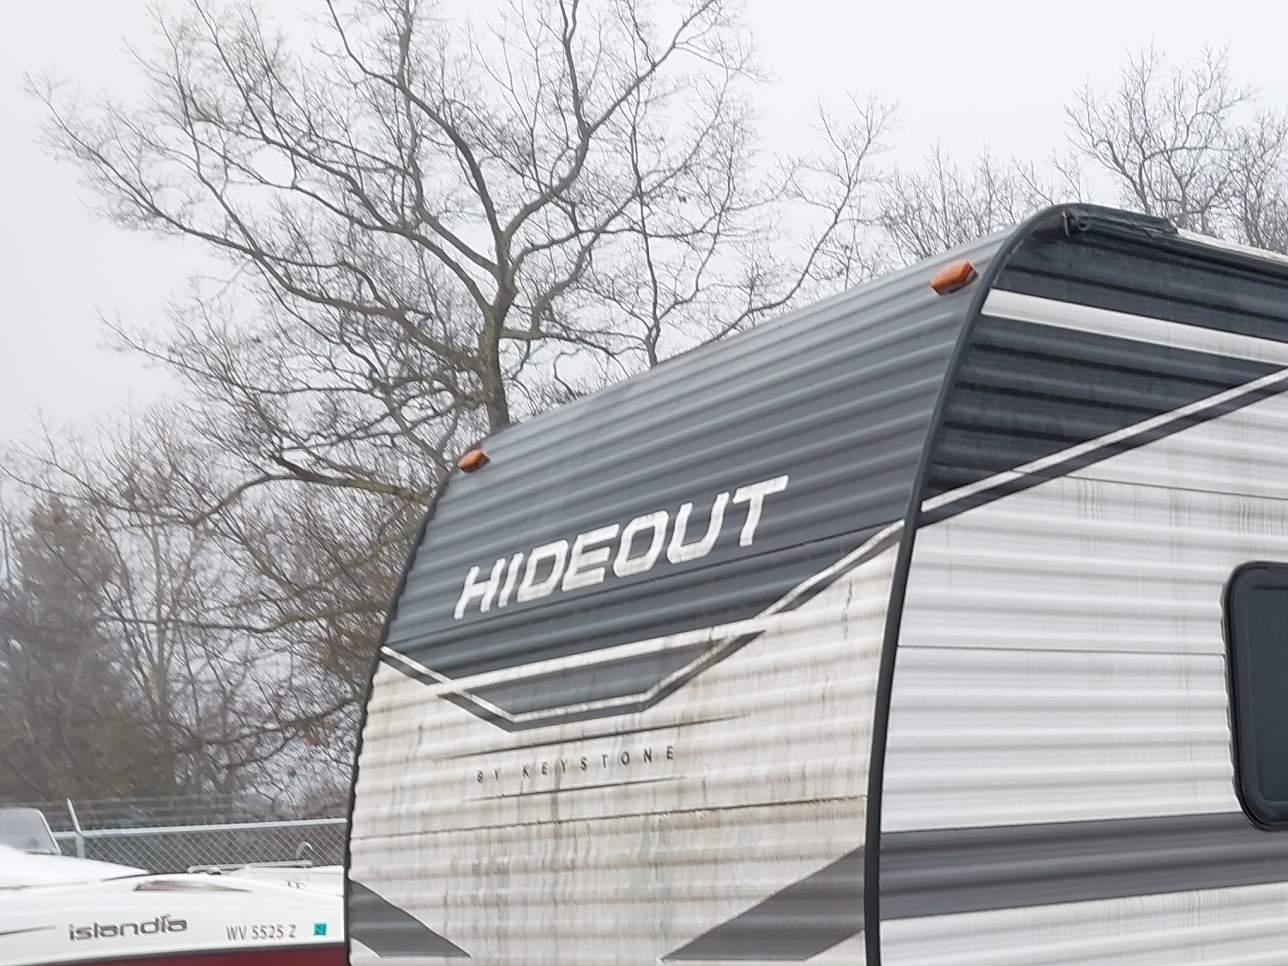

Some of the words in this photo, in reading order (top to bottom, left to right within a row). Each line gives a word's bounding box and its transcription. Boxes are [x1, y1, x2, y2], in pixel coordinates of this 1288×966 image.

[453, 474, 790, 621] HIDEOUT
[522, 745, 675, 777] KEYSTONE
[225, 925, 247, 941] WV
